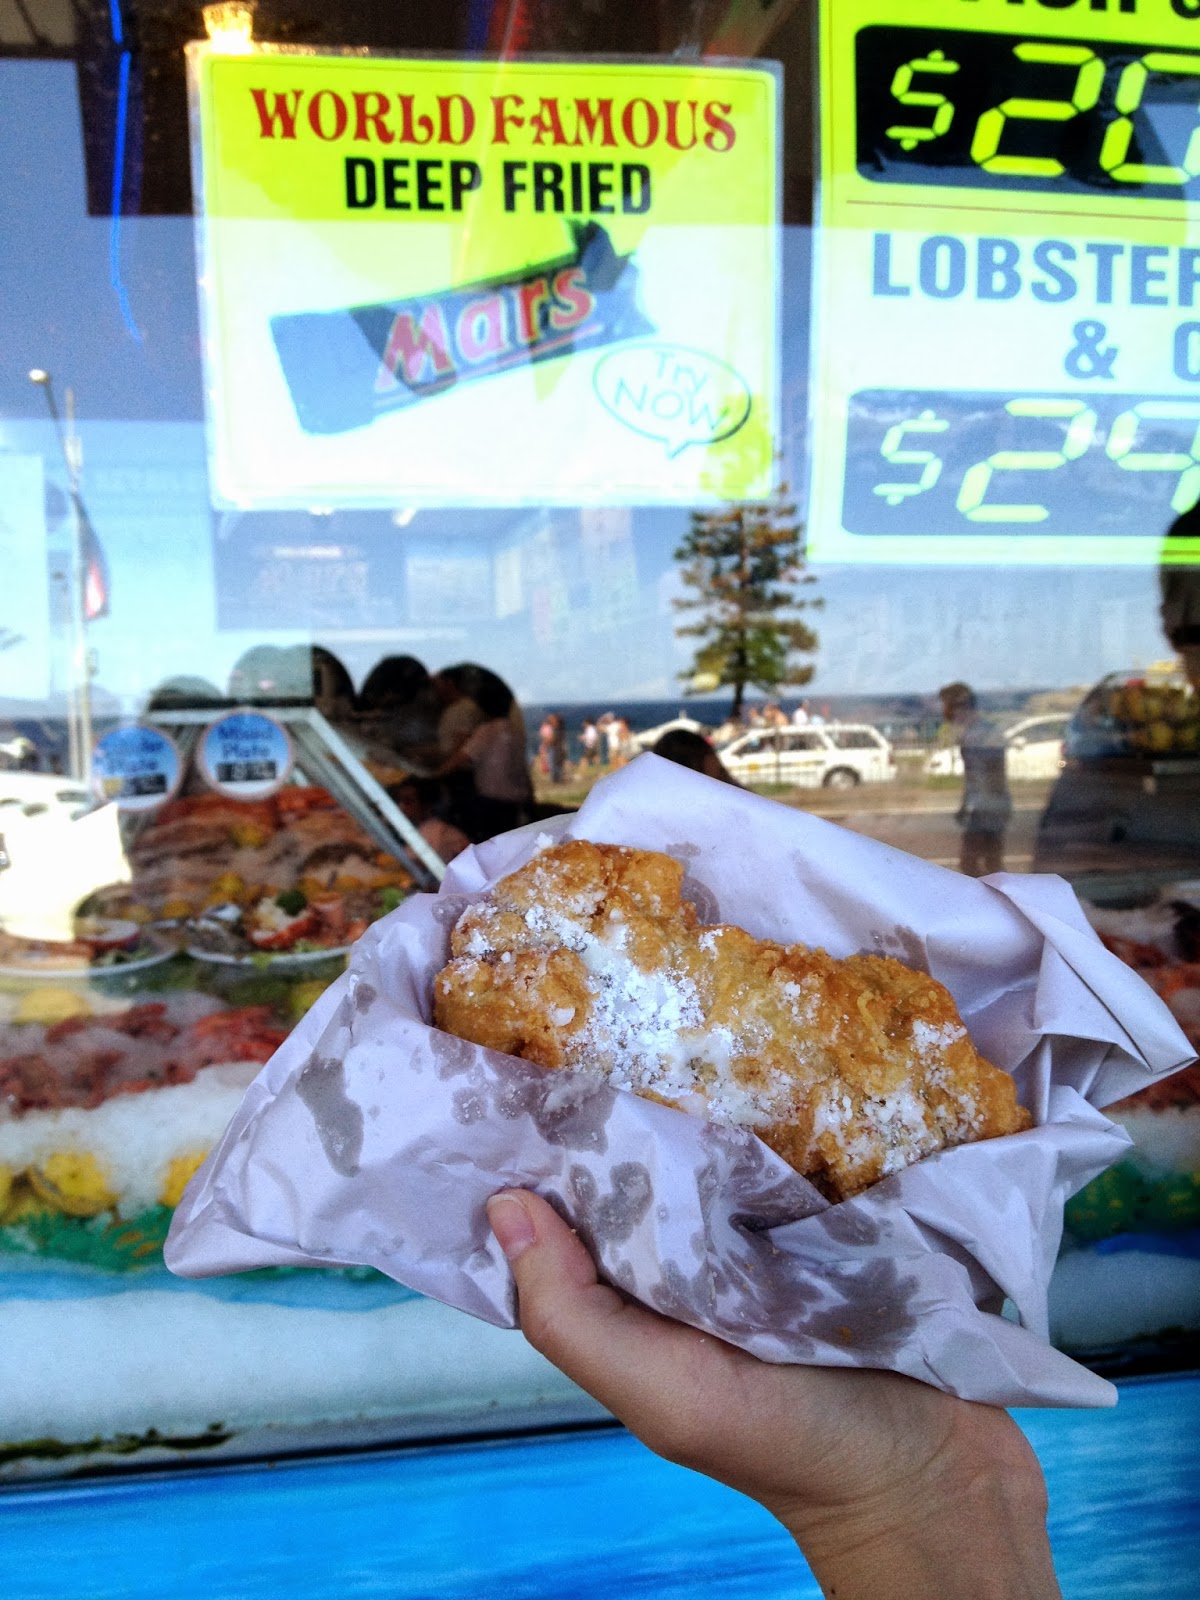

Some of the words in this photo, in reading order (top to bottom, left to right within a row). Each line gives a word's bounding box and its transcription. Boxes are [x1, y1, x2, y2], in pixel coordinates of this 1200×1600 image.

[249, 87, 476, 146] WORLD
[489, 94, 737, 153] FAMOUS
[344, 156, 483, 213] DEEP
[502, 161, 653, 216] FRIED
[373, 265, 597, 394] Mars
[1064, 319, 1118, 380] &
[614, 376, 731, 431] NOW
[654, 350, 709, 399] Try
